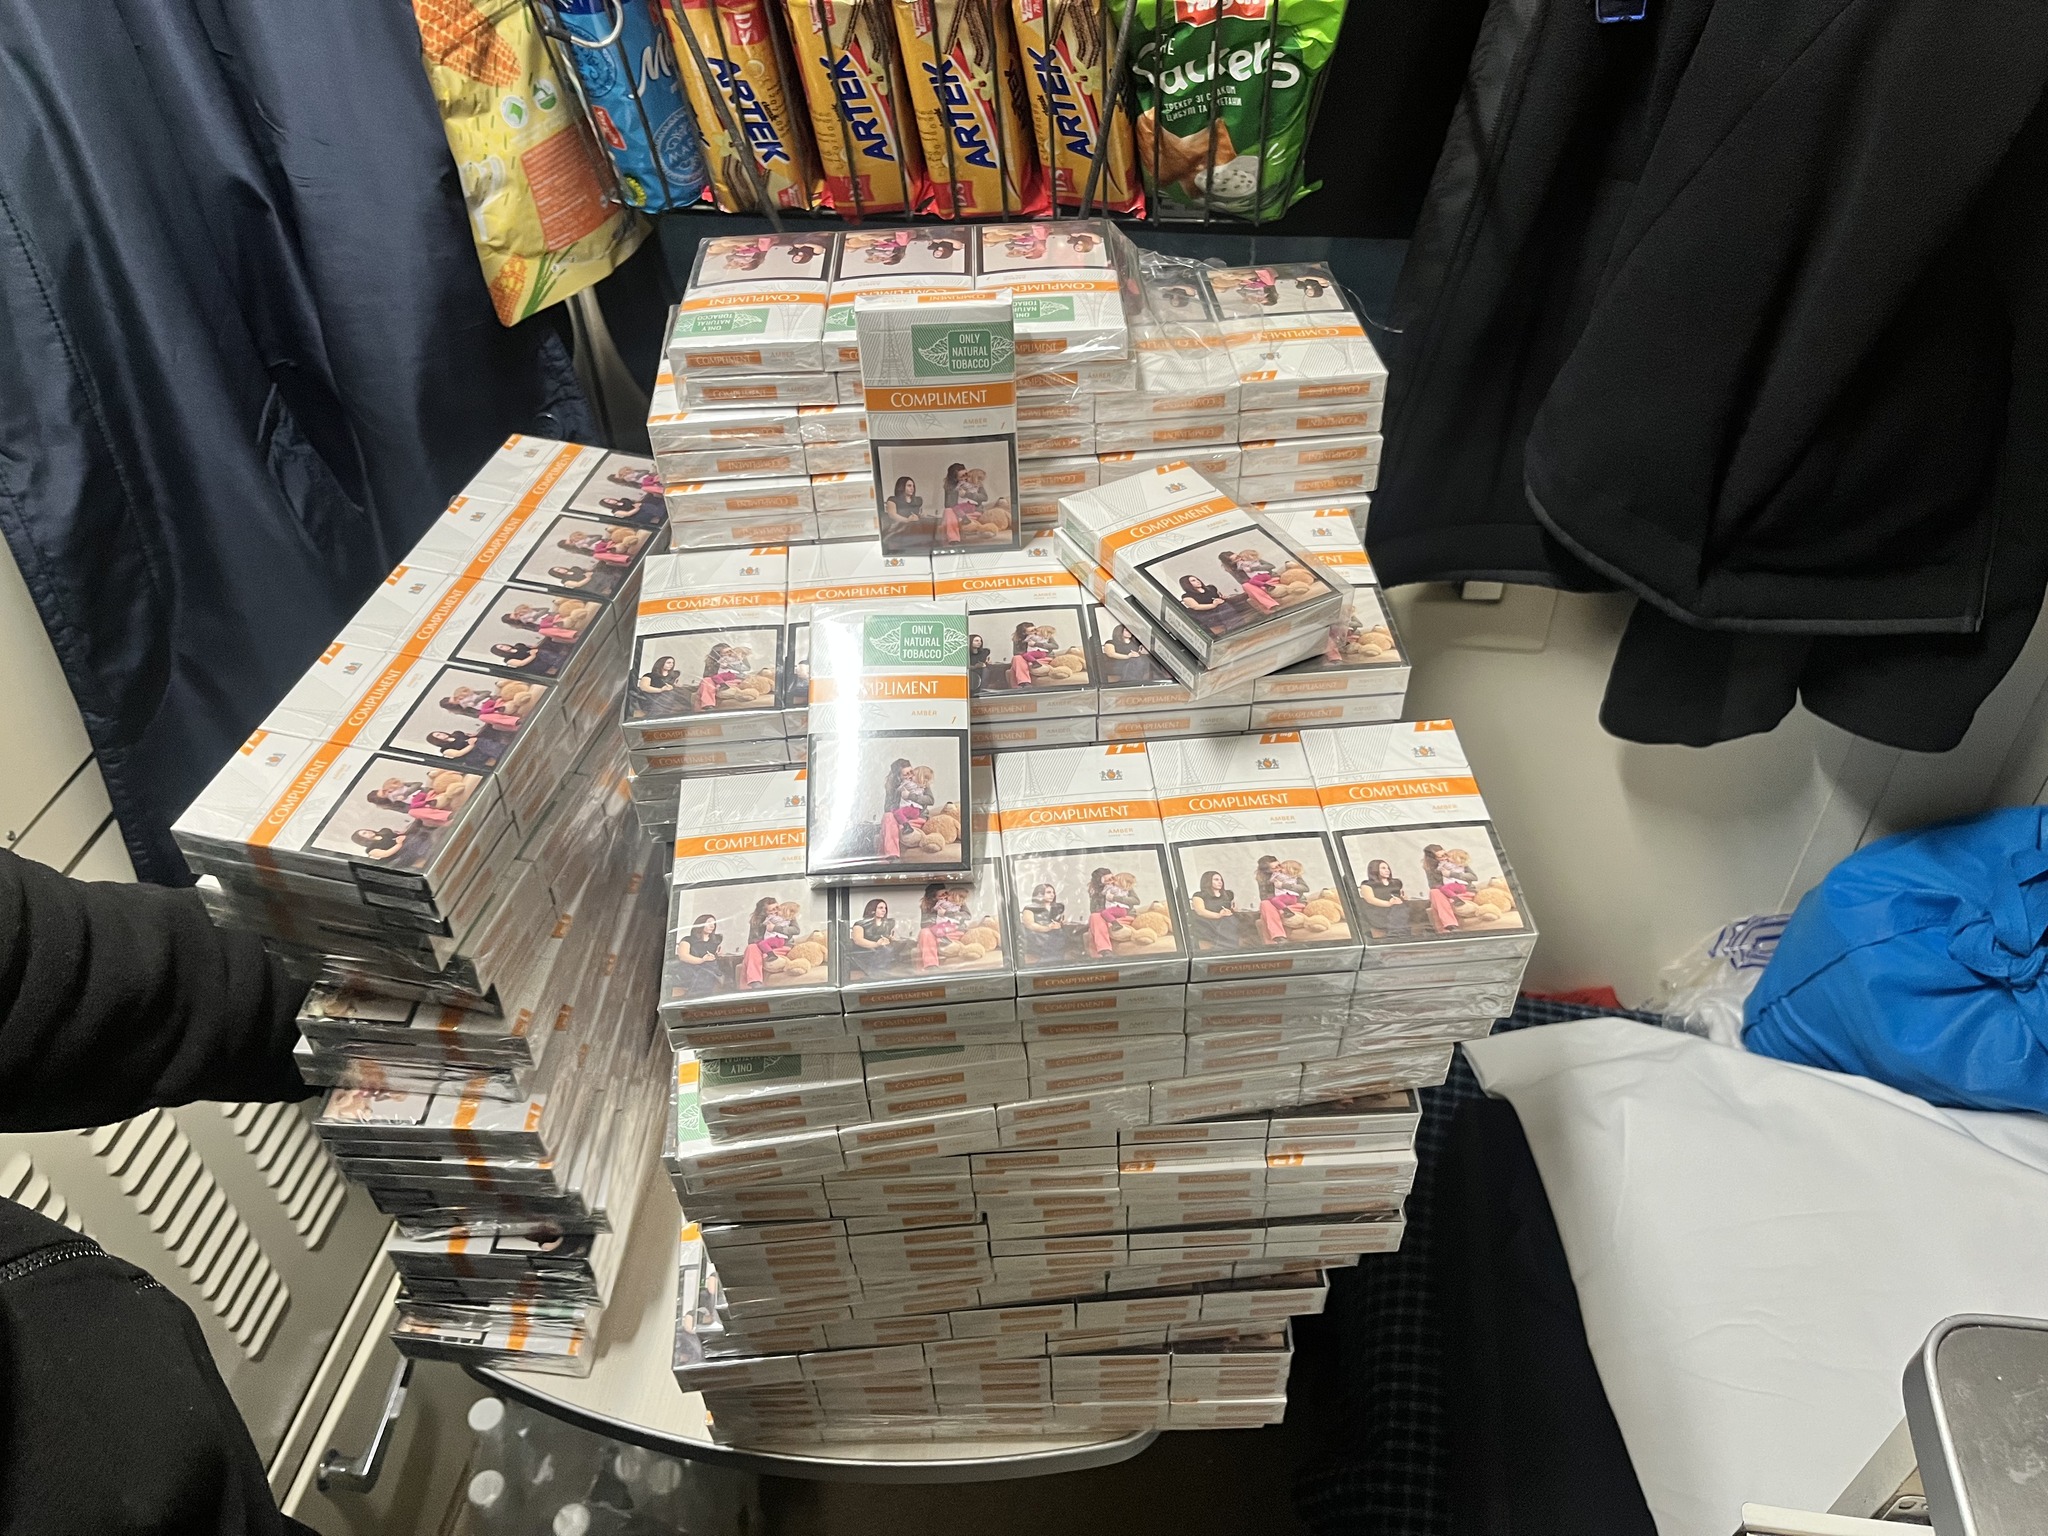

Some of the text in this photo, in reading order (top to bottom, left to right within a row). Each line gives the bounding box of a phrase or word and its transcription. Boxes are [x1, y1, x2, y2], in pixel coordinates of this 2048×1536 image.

[1206, 86, 1237, 101] САКОМ
[707, 57, 791, 164] ARTEK
[819, 54, 895, 162] ARTEK
[1027, 47, 1095, 160] ARTEK
[922, 59, 998, 169] ARTEK
[708, 293, 800, 306] COMPLIMENT
[697, 312, 735, 320] TOBACCO
[959, 333, 980, 344] ONLY
[1252, 328, 1339, 341] COMPLIMENT
[952, 346, 989, 357] NATURAL
[1016, 341, 1056, 351] MPLIMENT
[696, 354, 750, 366] COMPLIMENT
[951, 359, 990, 370] TOBACCO
[891, 389, 987, 408] COMPLIMENT
[963, 417, 987, 425] AMBER
[532, 454, 571, 495] COMPLIMENT
[1130, 504, 1213, 539] COMPLIMENT
[478, 517, 522, 563] COMPLIMENT
[962, 575, 1054, 591] COMPLIMENT
[816, 585, 908, 600] COMPLIMENT
[667, 595, 760, 611] COMPLIMENT
[417, 589, 465, 640] COMPLIMENT
[912, 625, 933, 635] ONLY
[903, 637, 941, 647] NATURAL
[902, 649, 942, 659] TOBACCO
[861, 680, 939, 696] MPLIMENT
[348, 669, 402, 727] COMPLIMENT
[1124, 721, 1180, 731] COMPLIMENT
[268, 759, 329, 825] COMPLIMENT
[1348, 781, 1450, 800] COMPLIMENT
[1188, 793, 1288, 812] COMPLIMENT
[1029, 804, 1129, 824] COMPLIMENT
[704, 831, 806, 852] COMPLIMENT
[1219, 962, 1281, 973] COMPLIMENT
[1045, 975, 1106, 987] COMPLIMENT
[871, 990, 934, 1002] COMPLIMENT
[731, 1062, 753, 1075] ONLY
